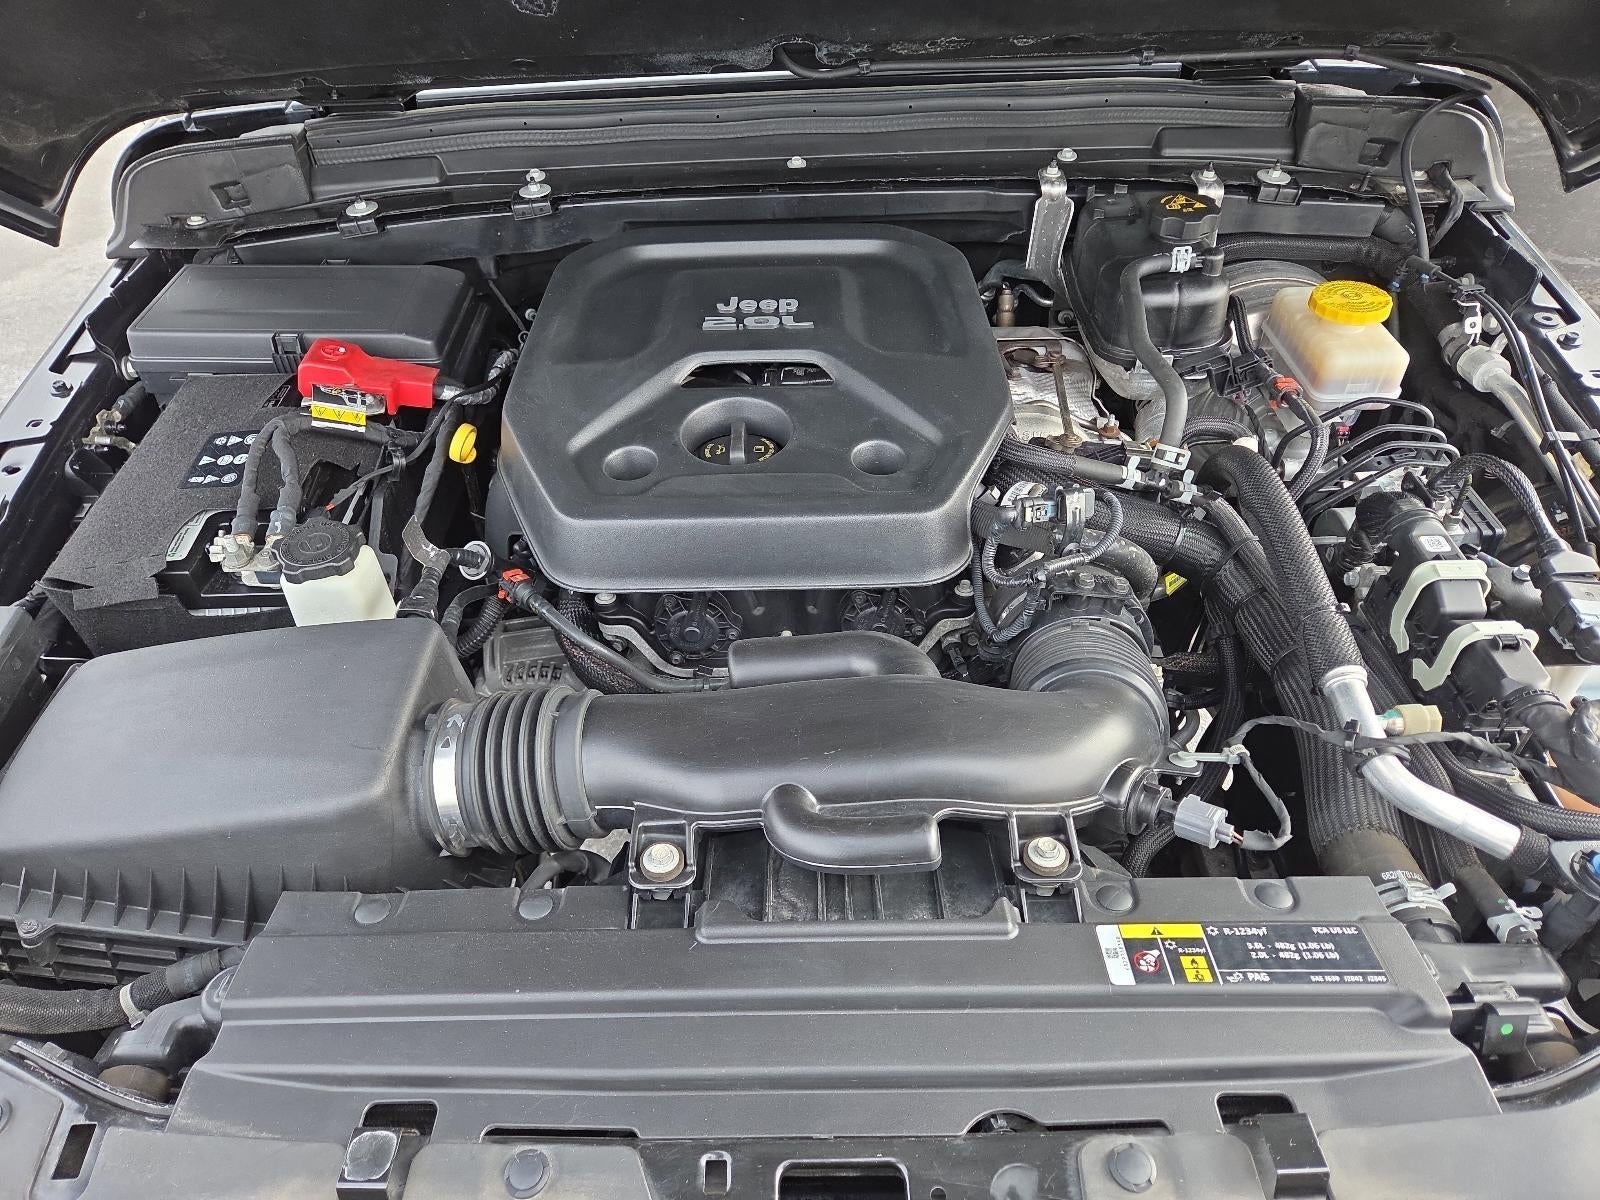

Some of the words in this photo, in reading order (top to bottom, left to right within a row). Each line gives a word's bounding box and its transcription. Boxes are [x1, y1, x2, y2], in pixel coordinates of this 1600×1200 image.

[716, 296, 799, 315] Jeep
[702, 316, 815, 331] 2.0L
[1222, 927, 1268, 937] R-1234yf
[1311, 926, 1330, 935] FCA
[1343, 926, 1359, 935] LLC
[1250, 951, 1269, 959] 2.0L
[1246, 972, 1271, 982] PAG
